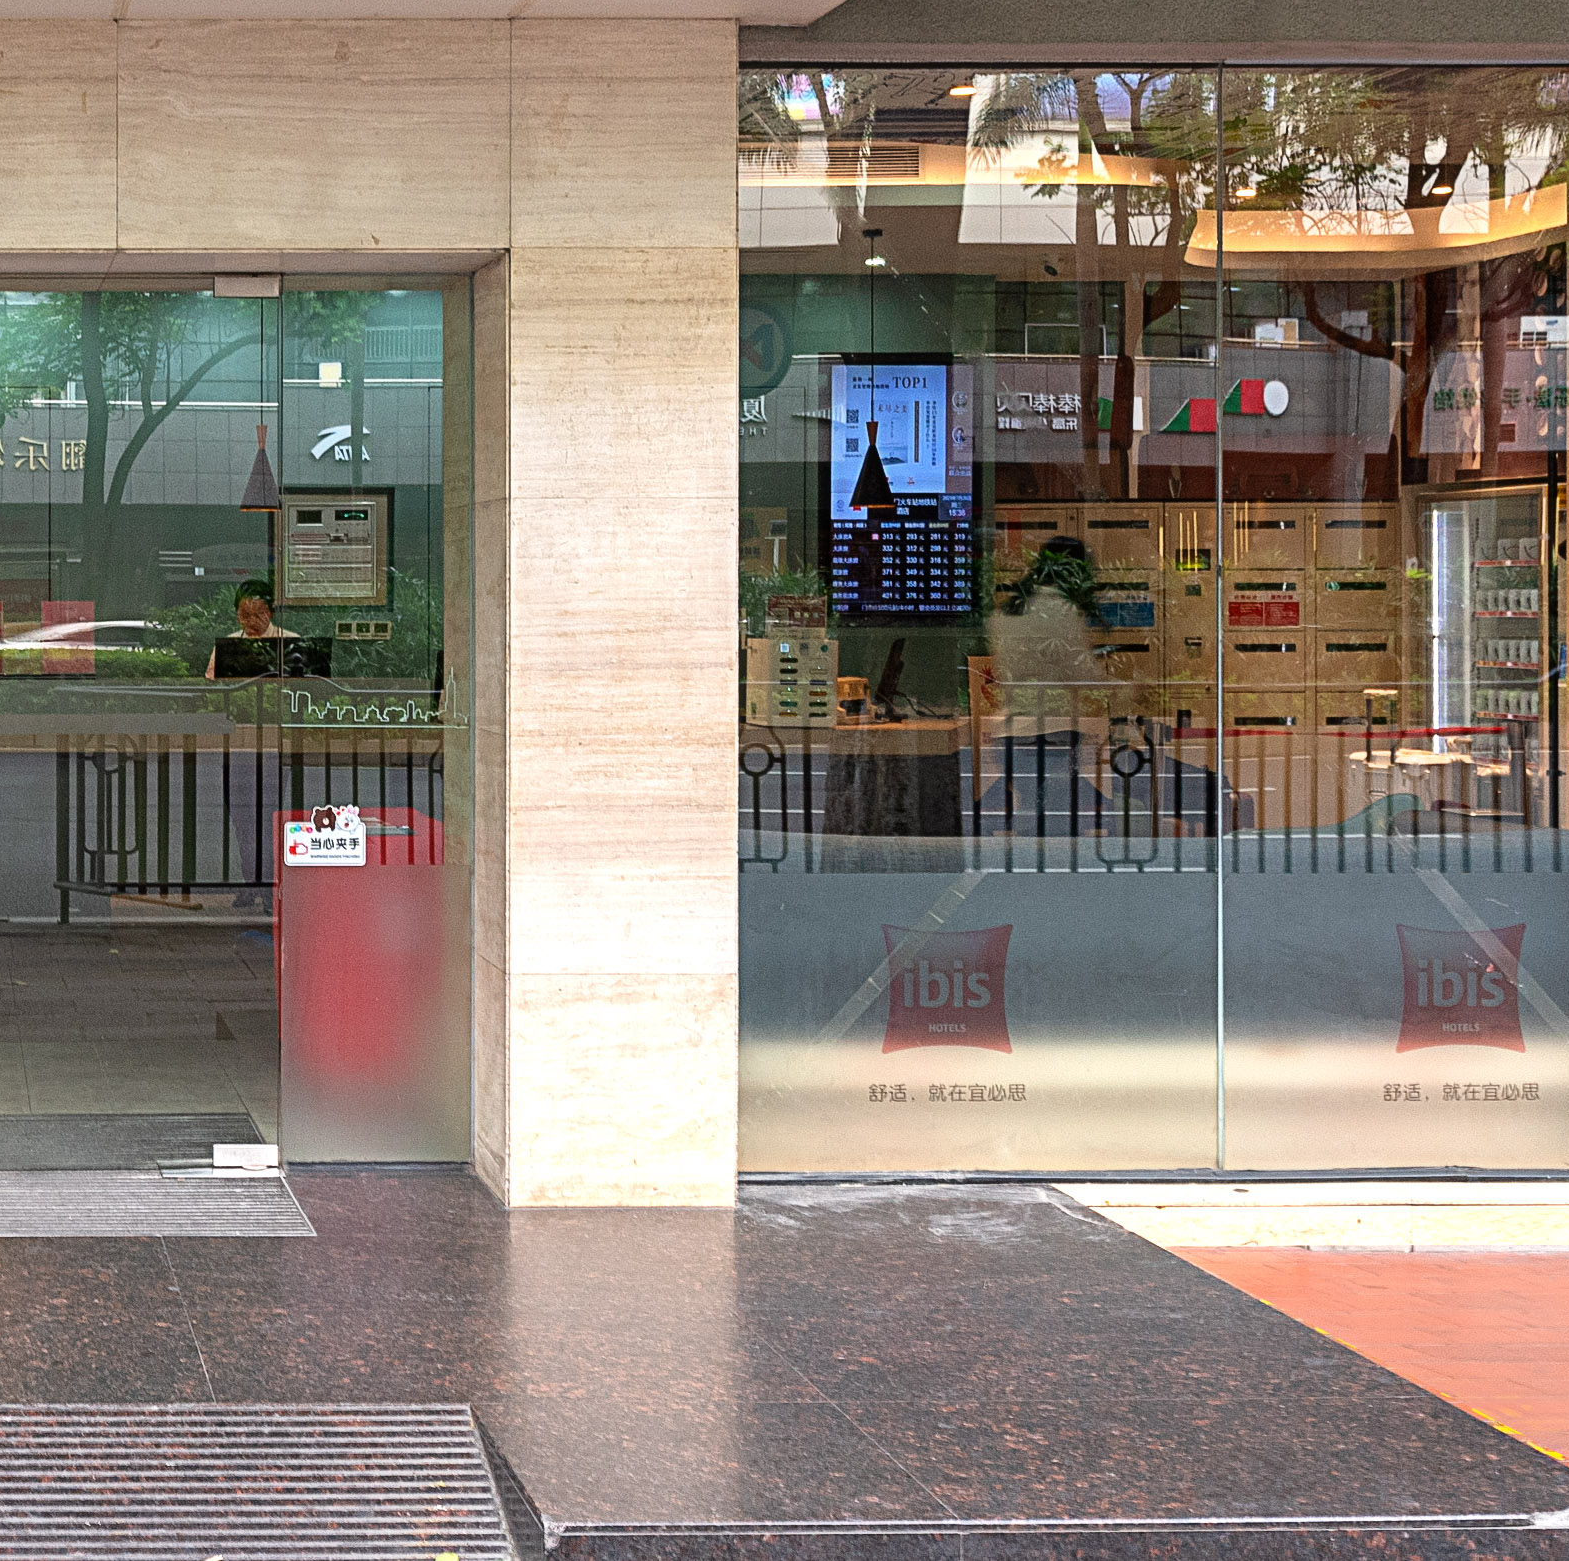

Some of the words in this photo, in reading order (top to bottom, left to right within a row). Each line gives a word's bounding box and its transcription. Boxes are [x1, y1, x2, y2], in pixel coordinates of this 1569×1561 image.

[892, 376, 928, 389] TOP1
[310, 837, 360, 851] 当心夹手
[902, 959, 992, 1009] ibis
[1415, 958, 1505, 1009] ibis
[927, 1022, 967, 1033] HOTELS
[1441, 1022, 1481, 1032] HOTELS
